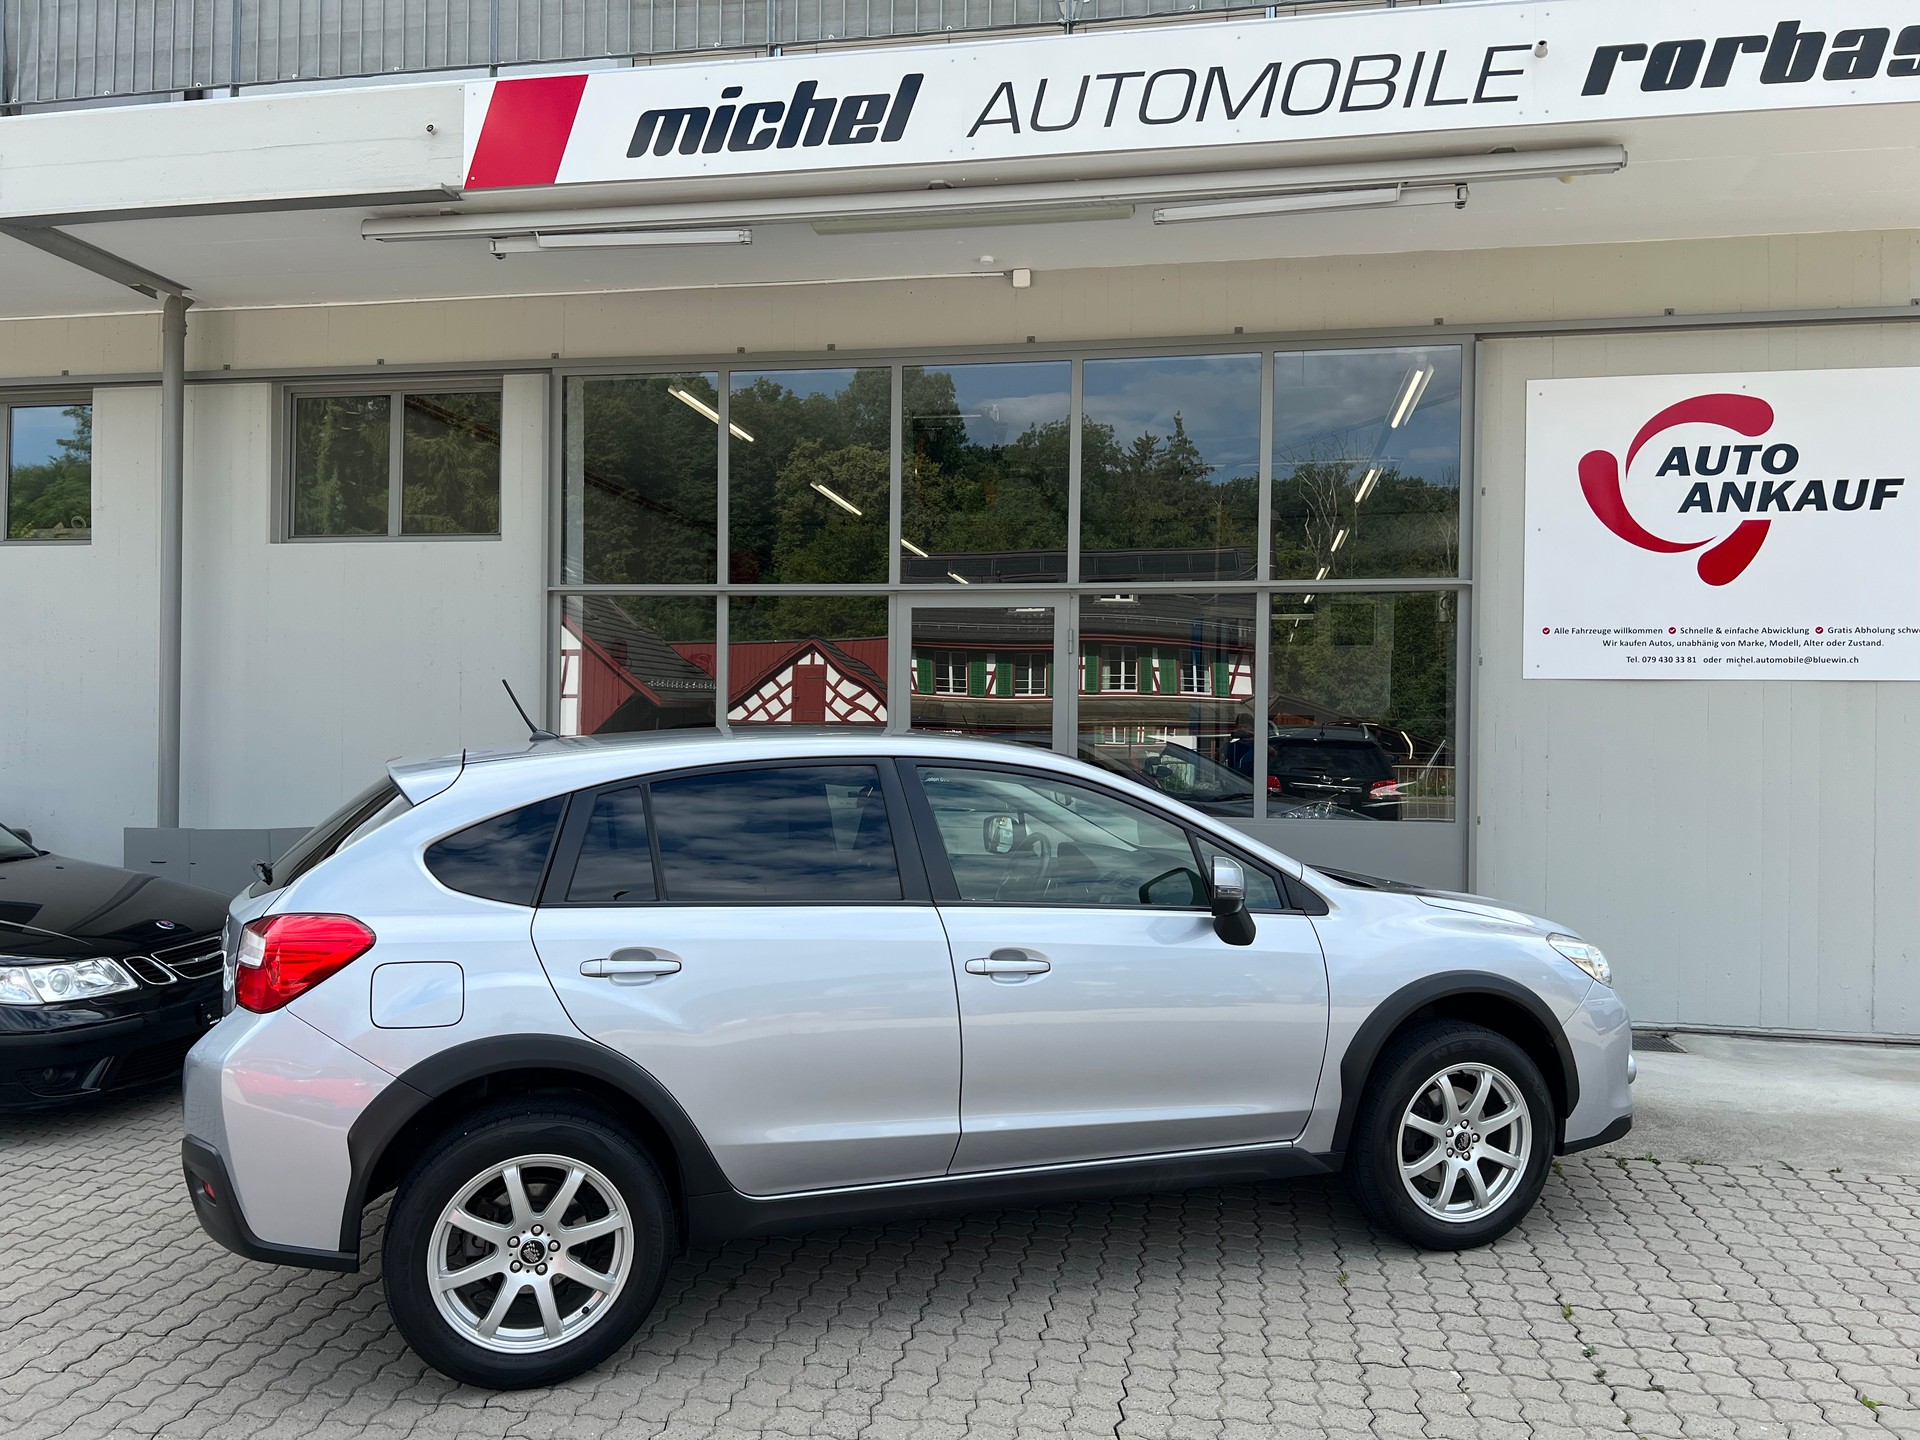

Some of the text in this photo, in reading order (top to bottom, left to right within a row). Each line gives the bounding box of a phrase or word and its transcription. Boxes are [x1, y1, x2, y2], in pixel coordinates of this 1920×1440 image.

[626, 73, 925, 159] michel
[966, 43, 1534, 139] AUTOMOBILE
[1654, 442, 1799, 477] AUTO
[1677, 477, 1905, 514] ANKAUF
[1554, 627, 1569, 635] Alle
[1571, 627, 1612, 636] Fahrzeuge
[1613, 627, 1663, 635] willkommen
[1680, 626, 1714, 635] Schnelle
[1715, 627, 1722, 635] &
[1724, 626, 1760, 635] einfache
[1761, 626, 1810, 636] Abwicklung
[1827, 626, 1853, 635] Gratis
[1854, 626, 1896, 636] Abholung
[1602, 639, 1618, 647] Wir
[1619, 639, 1647, 647] kaufen
[1649, 639, 1675, 648] Autos,
[1676, 639, 1719, 648] unabhänig
[1737, 639, 1767, 648] Marke,
[1769, 639, 1801, 648] Modell,
[1803, 639, 1824, 647] Alter
[1826, 639, 1846, 647] oder
[1847, 639, 1884, 647] Zustand.
[1626, 655, 1859, 665] Tel. 079 430 33 81 oder michel.automobile@bluewin.ch
